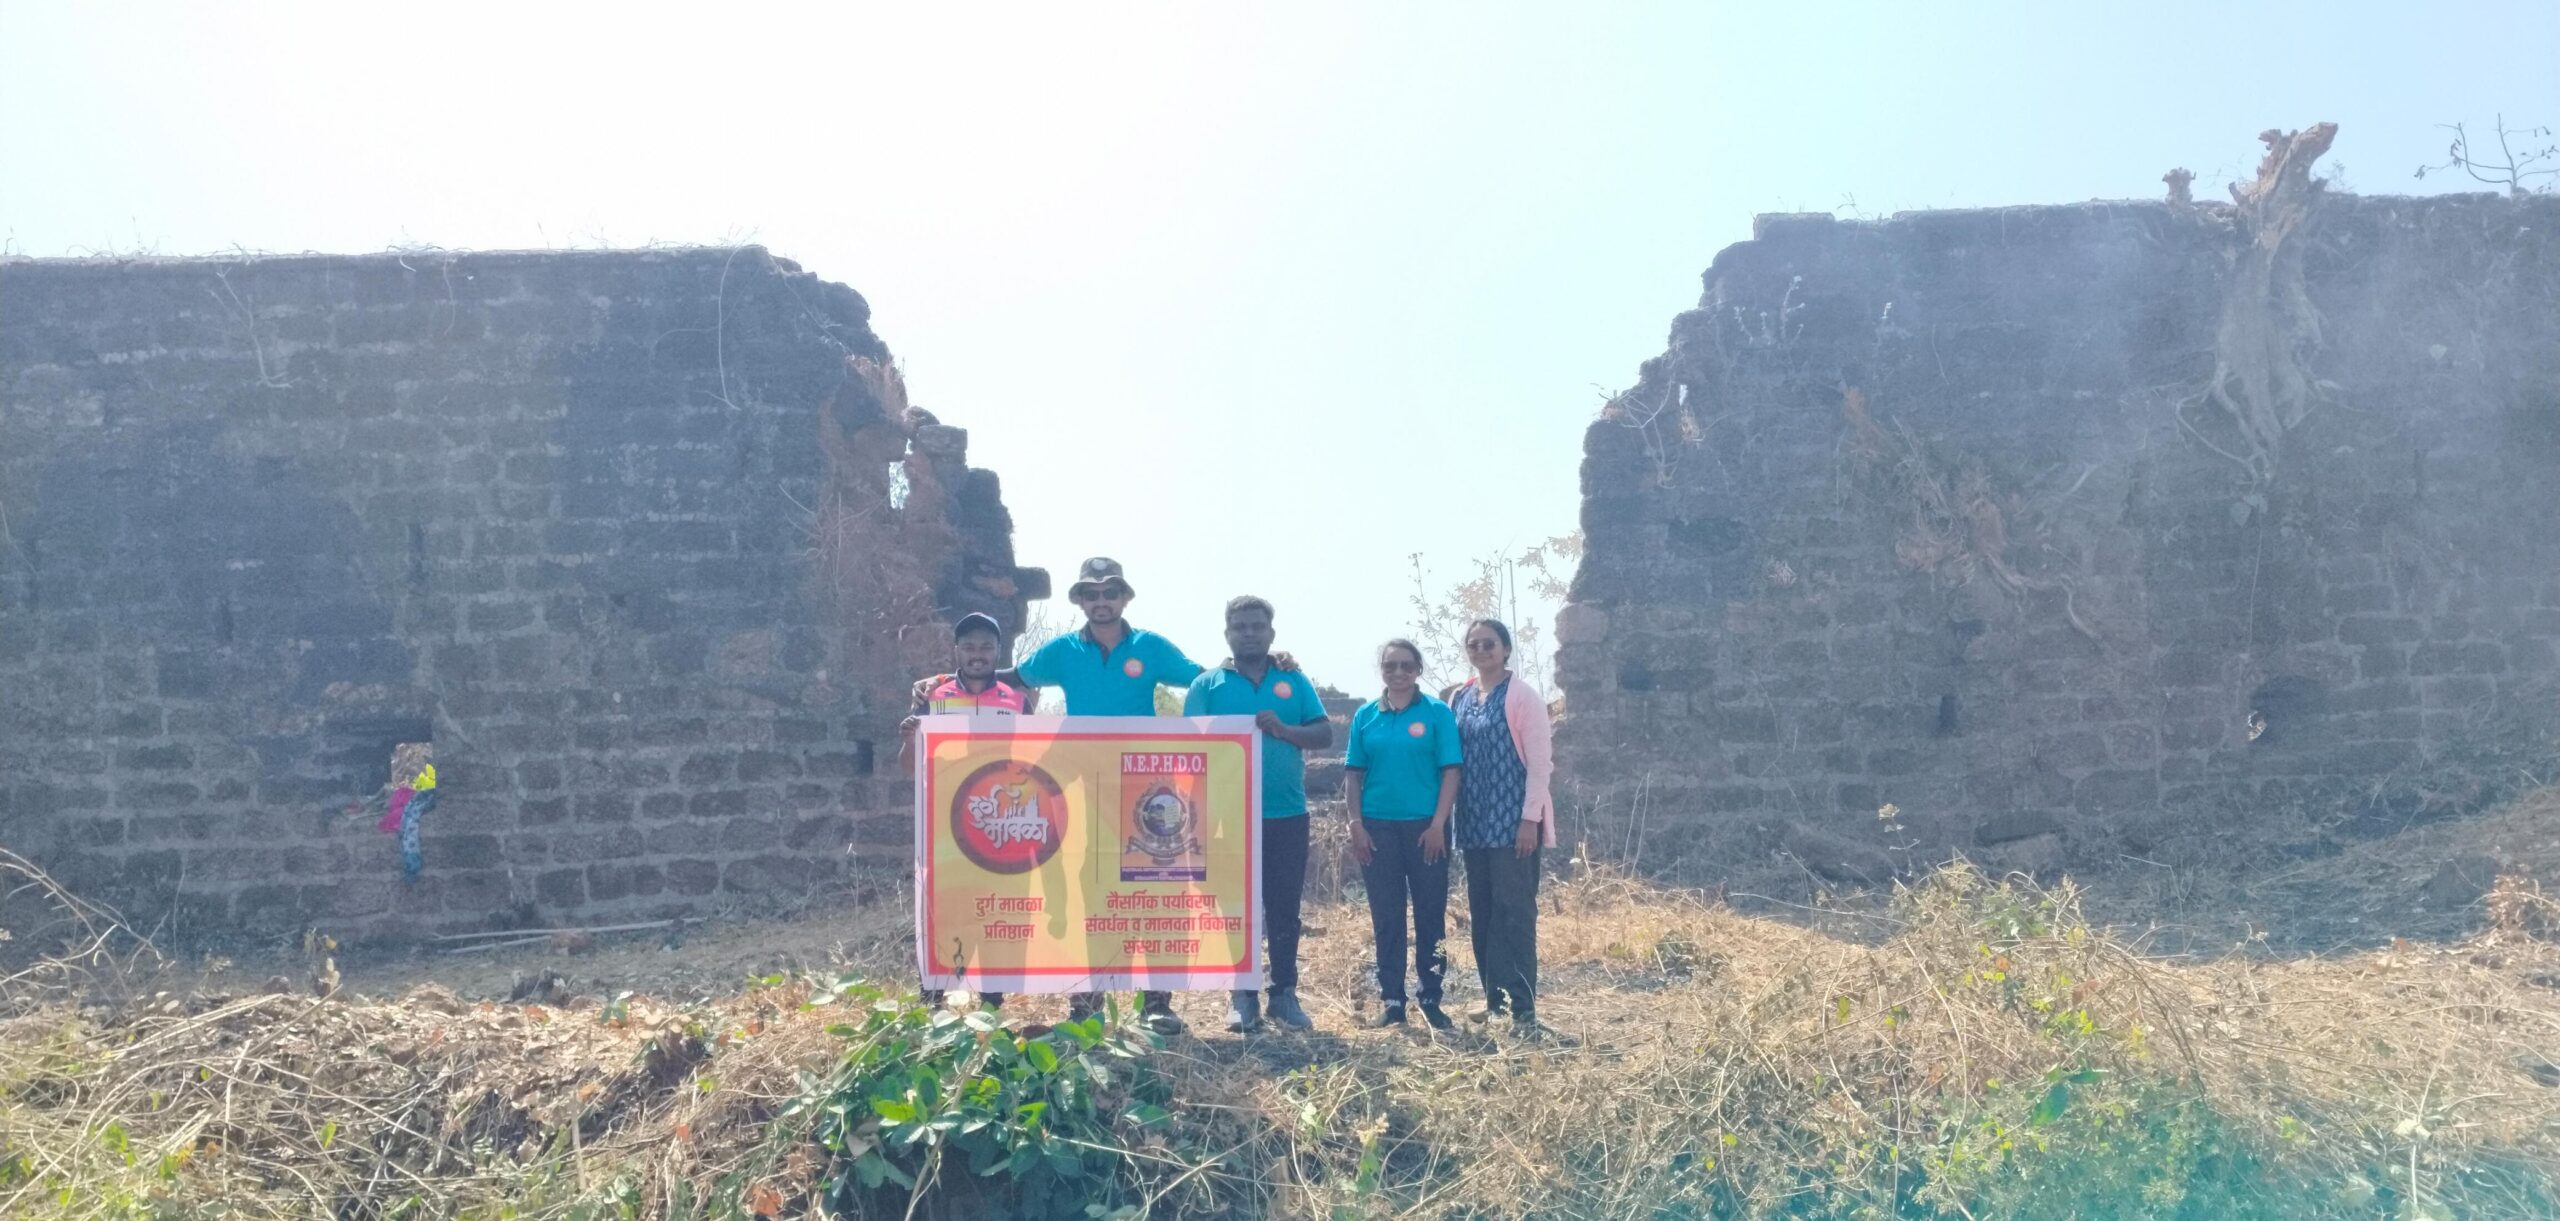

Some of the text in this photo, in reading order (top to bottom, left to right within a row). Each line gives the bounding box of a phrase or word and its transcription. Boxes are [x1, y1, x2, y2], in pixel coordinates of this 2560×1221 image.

[1123, 755, 1206, 773] N.E.P.H.D.O.
[975, 893, 1044, 917] दुर्ग मावळा
[1162, 891, 1217, 912] पर्यावरण
[984, 920, 1036, 940] प्रतिष्ठान
[1084, 914, 1242, 933] संवर्धन व मानवता विकास
[1122, 936, 1201, 955] संस्था भारत
